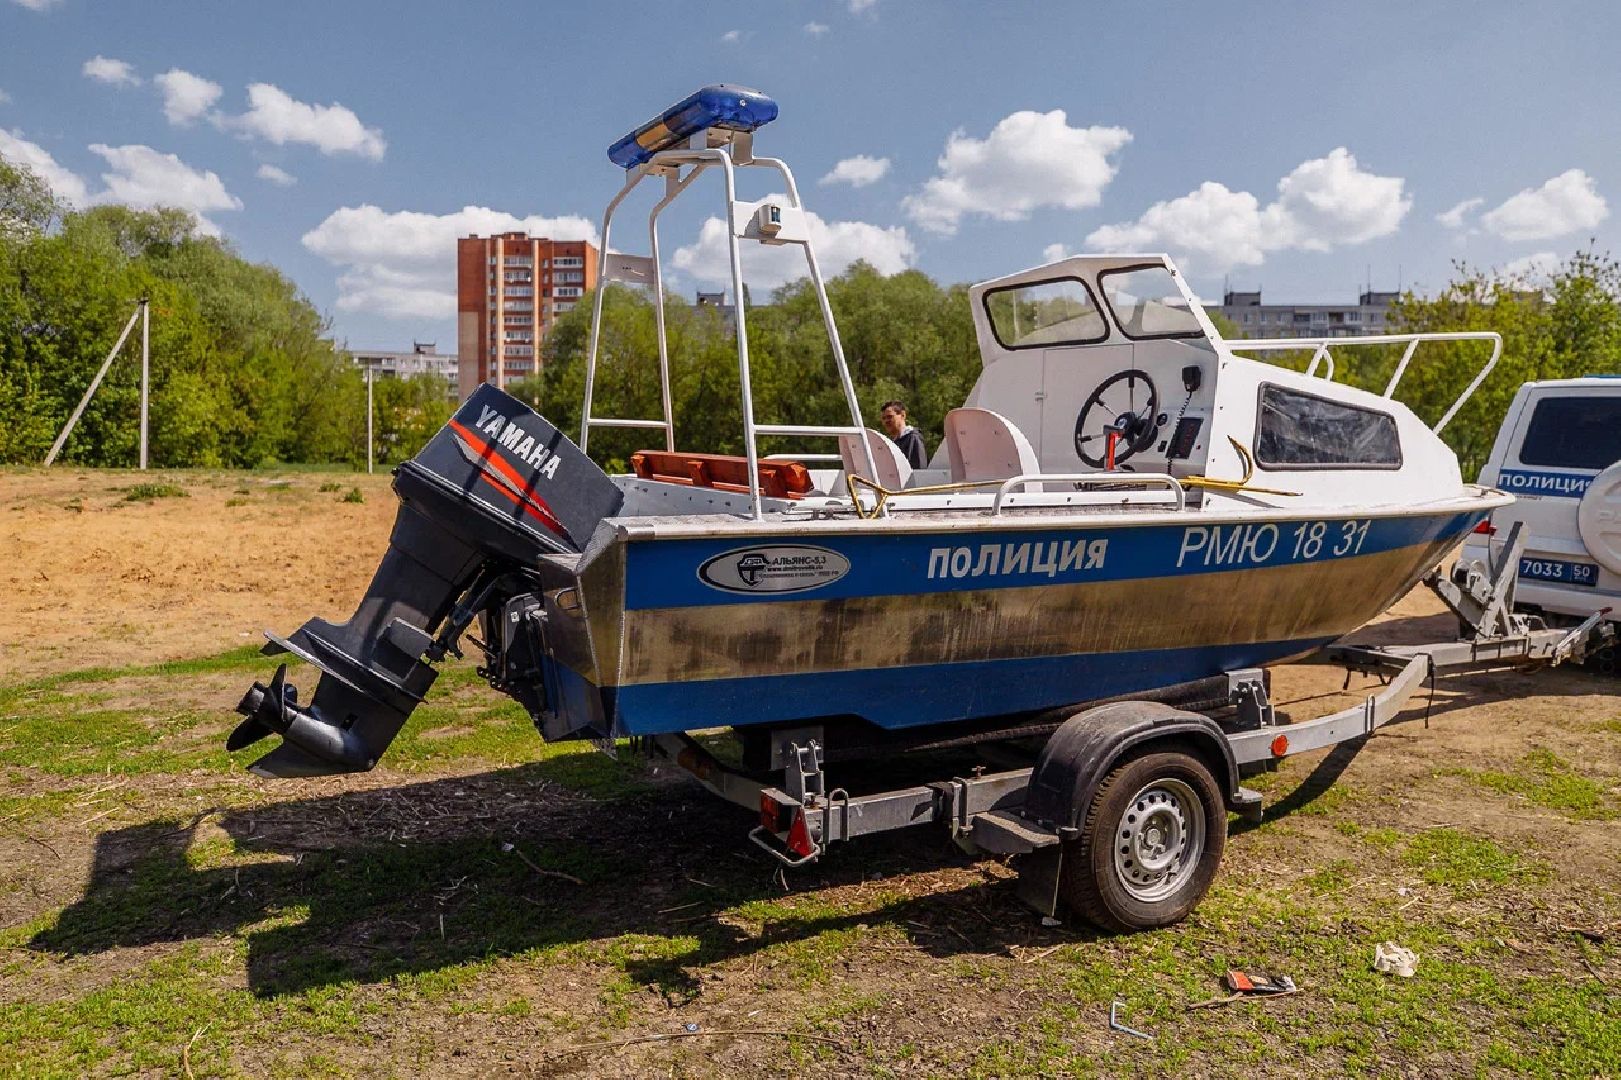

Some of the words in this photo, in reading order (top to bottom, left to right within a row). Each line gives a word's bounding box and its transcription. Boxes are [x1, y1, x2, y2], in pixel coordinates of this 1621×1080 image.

[476, 405, 561, 480] YAMAHA
[1499, 474, 1591, 492] ПОЛИЦИ
[927, 539, 1108, 579] ПОЛИЦИЯ
[1176, 524, 1278, 568] РМЮ
[1292, 521, 1327, 560] 18
[1334, 520, 1371, 556] 31
[1523, 559, 1563, 577] 7033
[1573, 565, 1590, 577] 50
